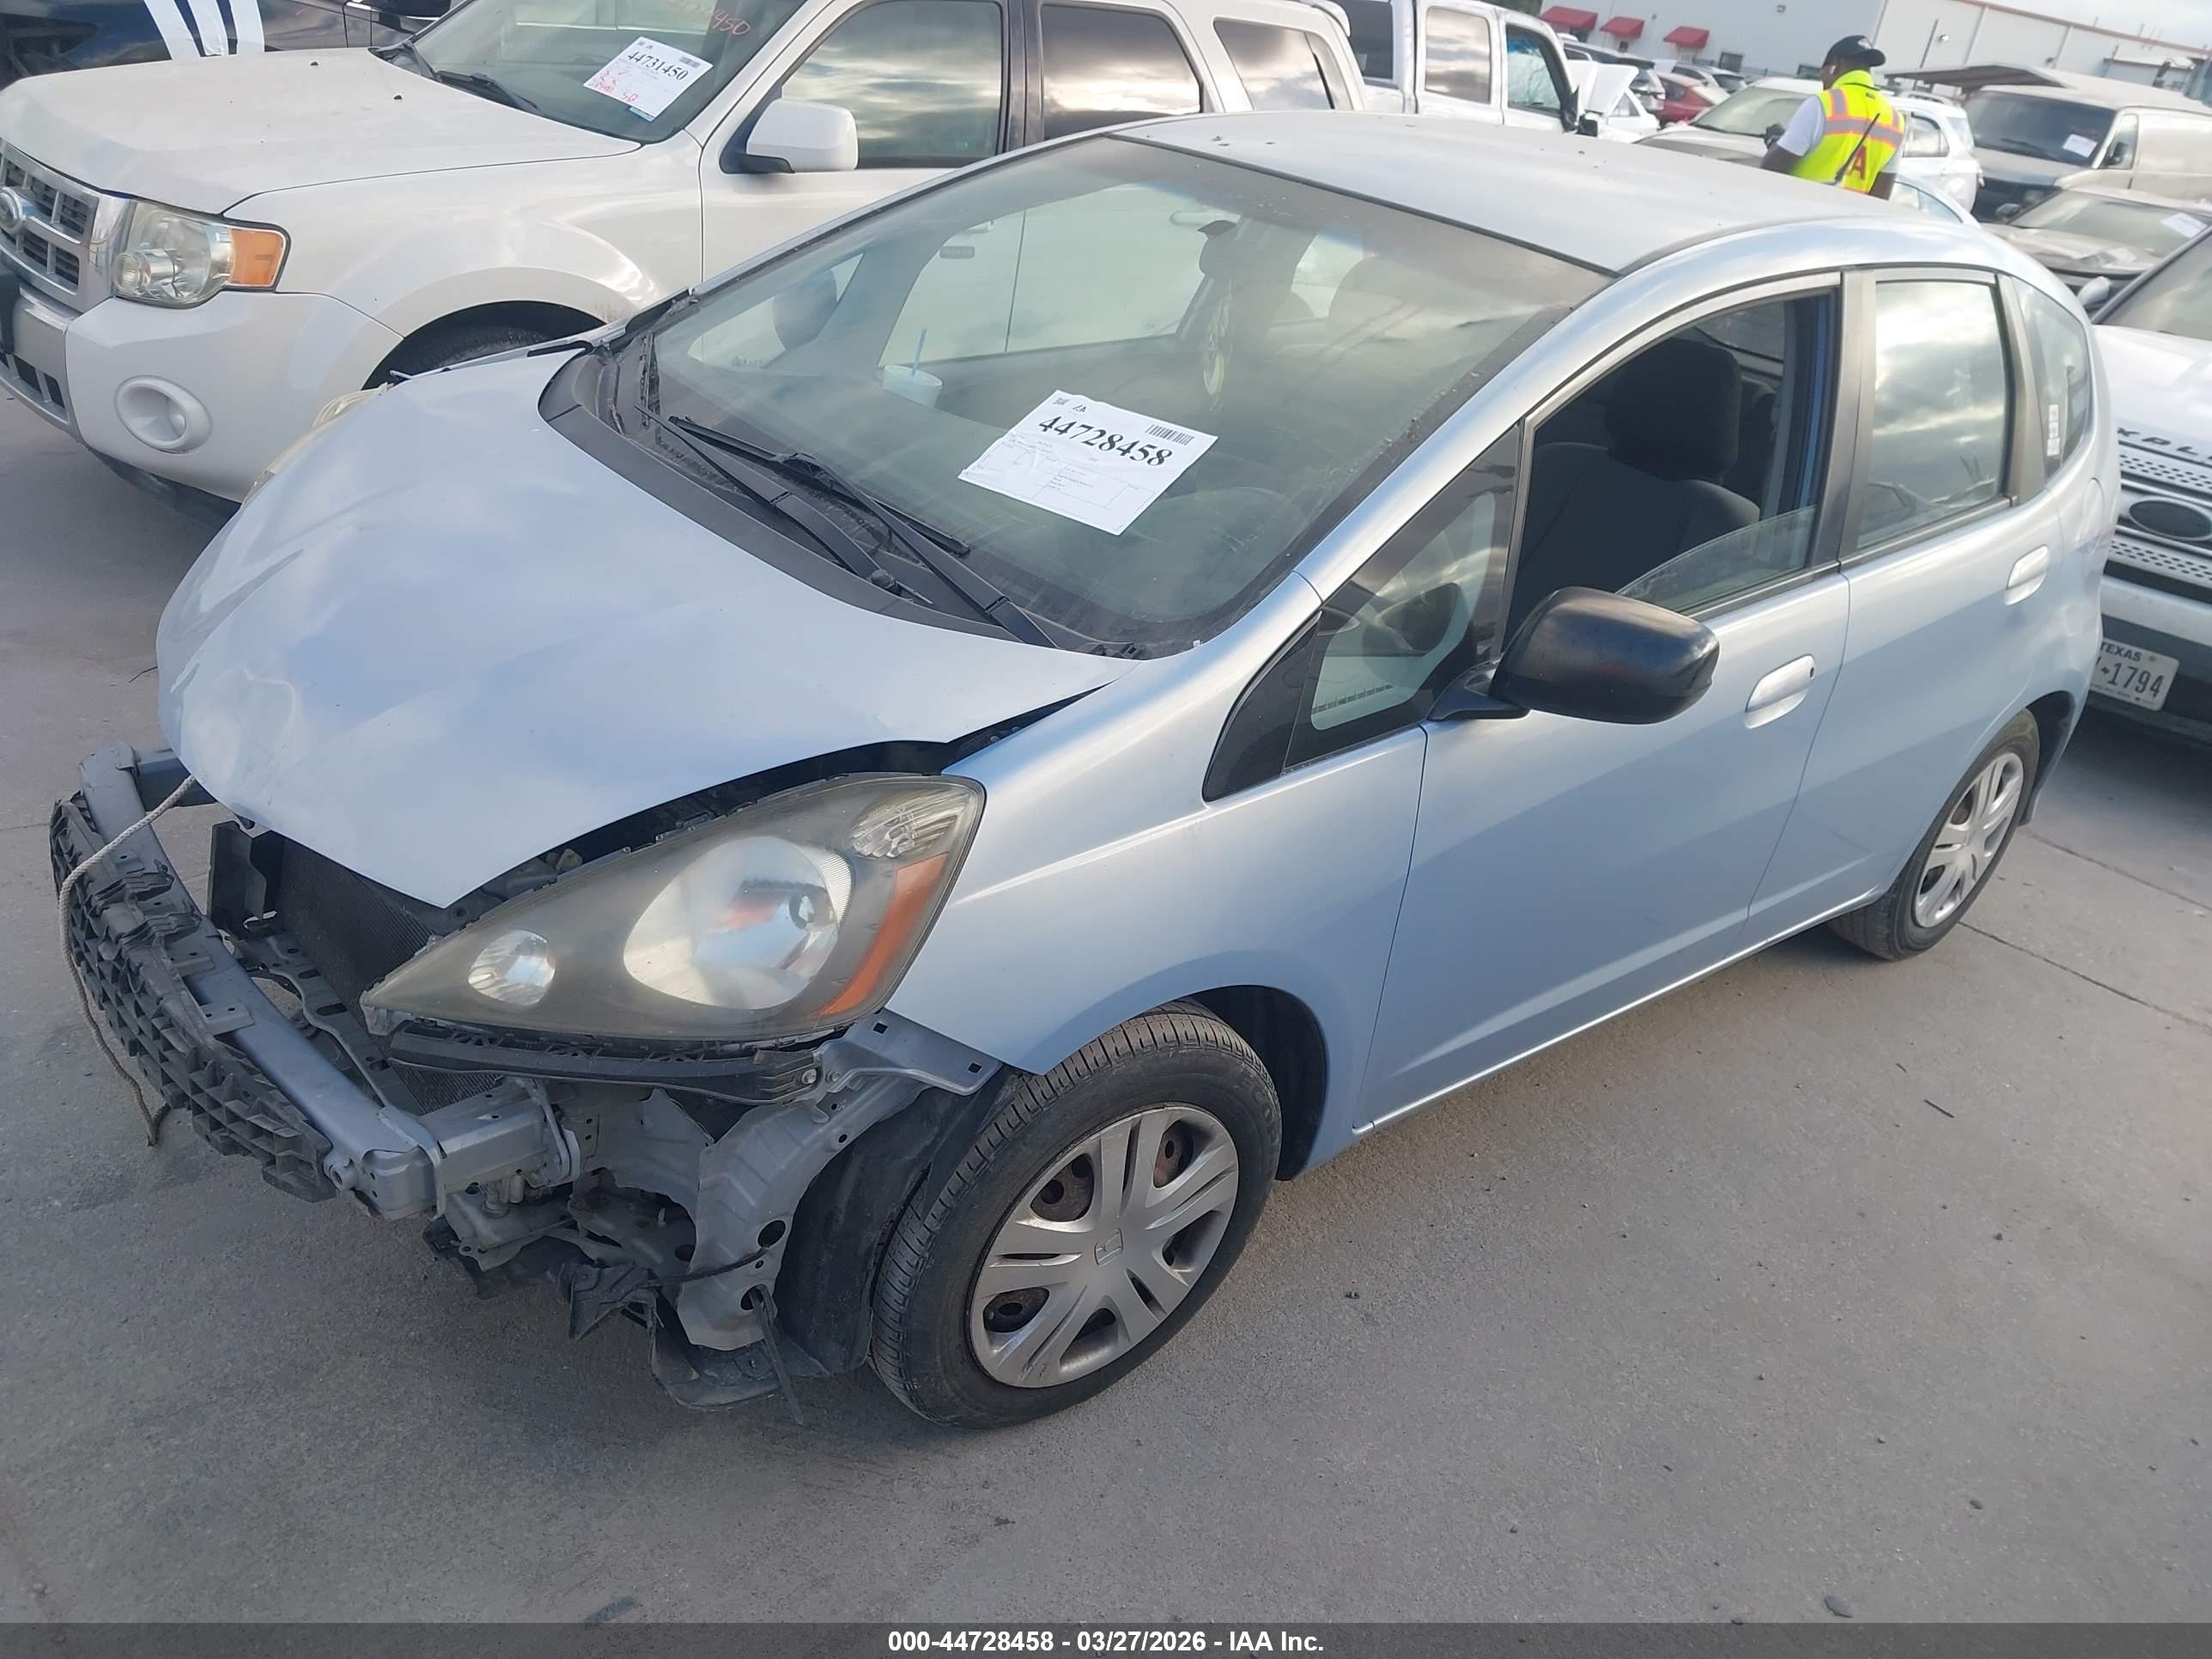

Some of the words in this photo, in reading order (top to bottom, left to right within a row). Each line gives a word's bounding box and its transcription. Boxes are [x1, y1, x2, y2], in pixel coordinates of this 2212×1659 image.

[628, 52, 689, 82] 44731450
[1038, 416, 1173, 466] 44728458
[2100, 641, 2142, 661] TEXAS
[2096, 656, 2164, 698] 1794
